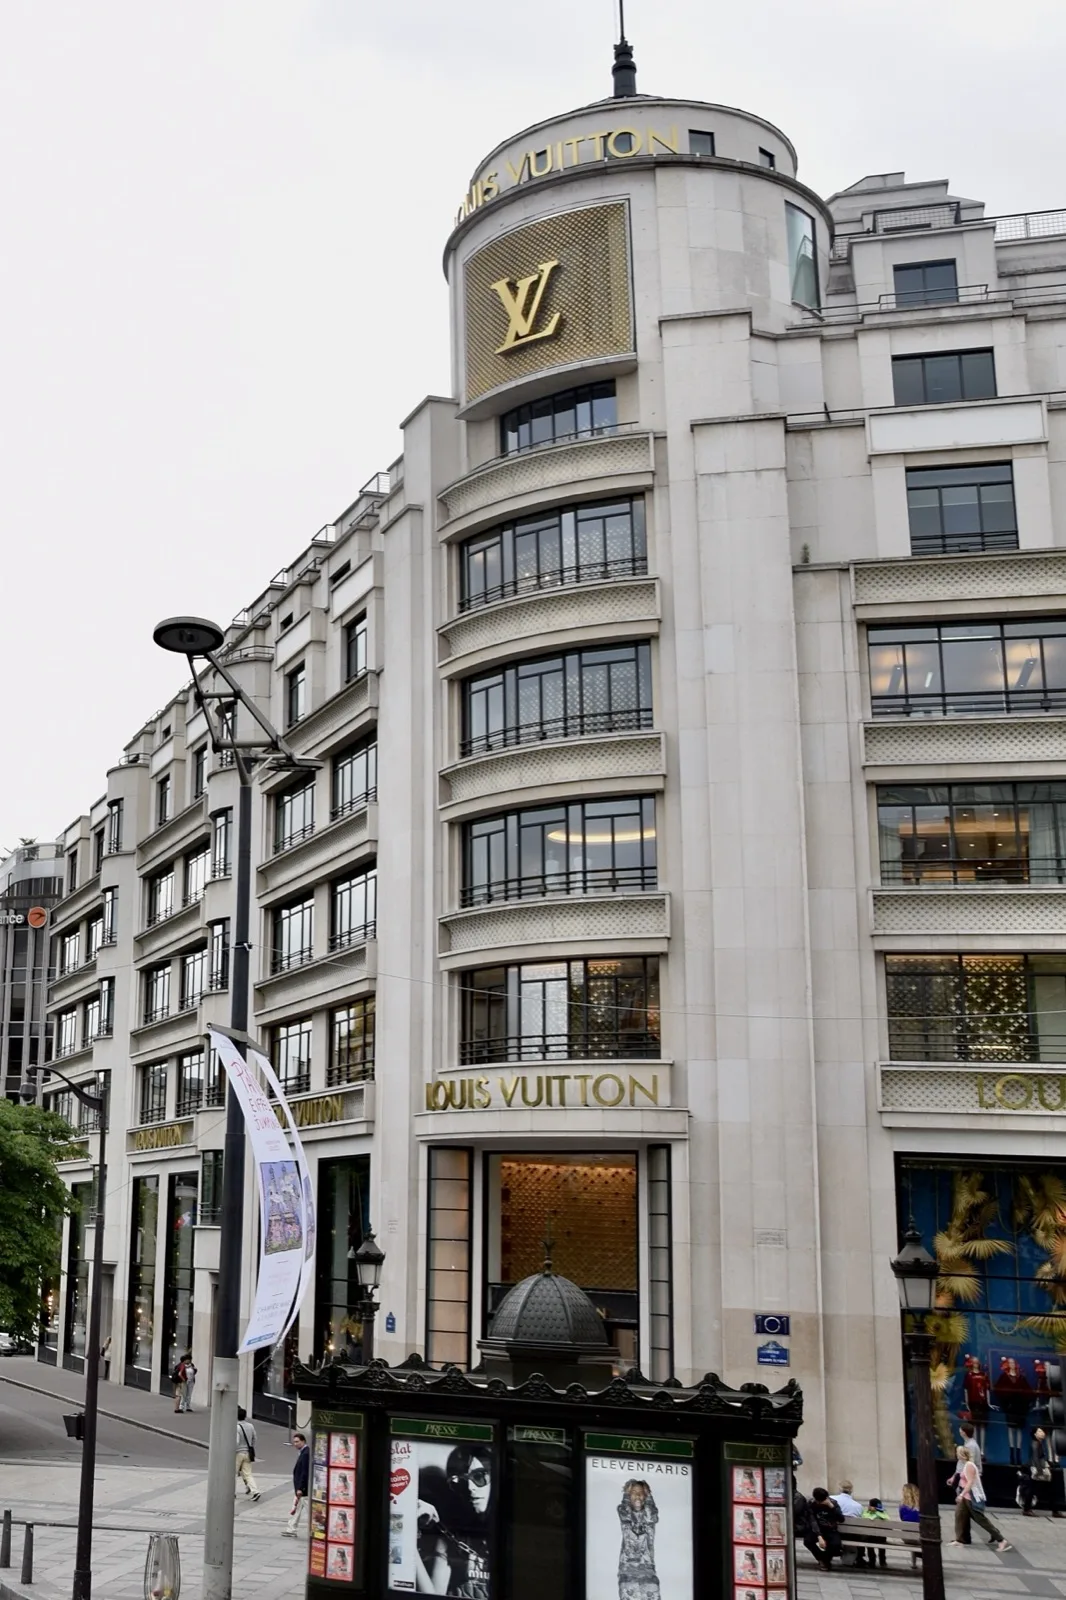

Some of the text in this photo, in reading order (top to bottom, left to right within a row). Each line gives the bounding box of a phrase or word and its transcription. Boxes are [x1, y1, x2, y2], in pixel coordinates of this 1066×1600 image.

[505, 125, 679, 185] VUITTON
[426, 1073, 659, 1111] LOUIS VUITTON
[976, 1074, 1066, 1111] LOU
[425, 1423, 460, 1437] PRESSE
[522, 1428, 558, 1441] PRESSE
[621, 1438, 658, 1452] PRESSE
[591, 1458, 690, 1477] ELEVENPARIS
